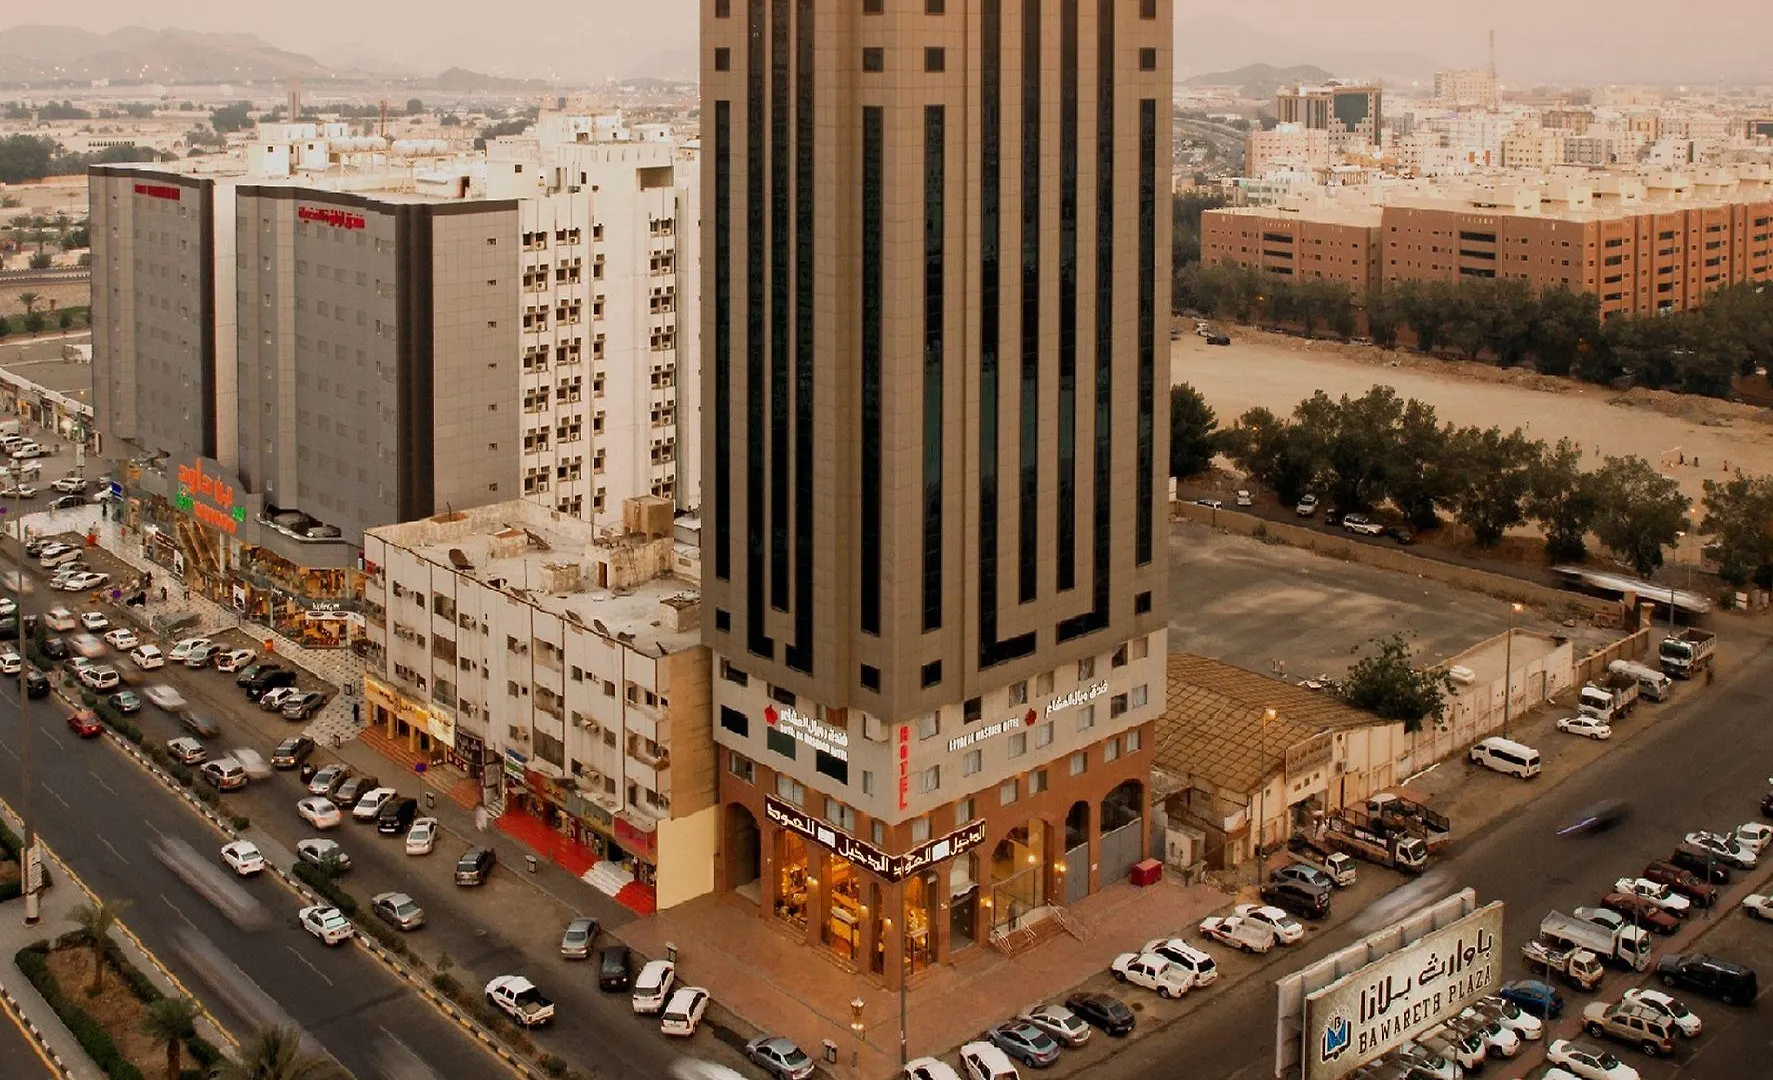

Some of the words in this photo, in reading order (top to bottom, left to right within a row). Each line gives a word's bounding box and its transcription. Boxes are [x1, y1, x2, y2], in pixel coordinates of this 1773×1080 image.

[899, 725, 908, 811] HOTEL
[1418, 928, 1493, 986] باوارث
[1358, 991, 1441, 1054] BAWARETH
[1447, 965, 1492, 1004] PLAZA
[1359, 975, 1412, 1024] بلازا
